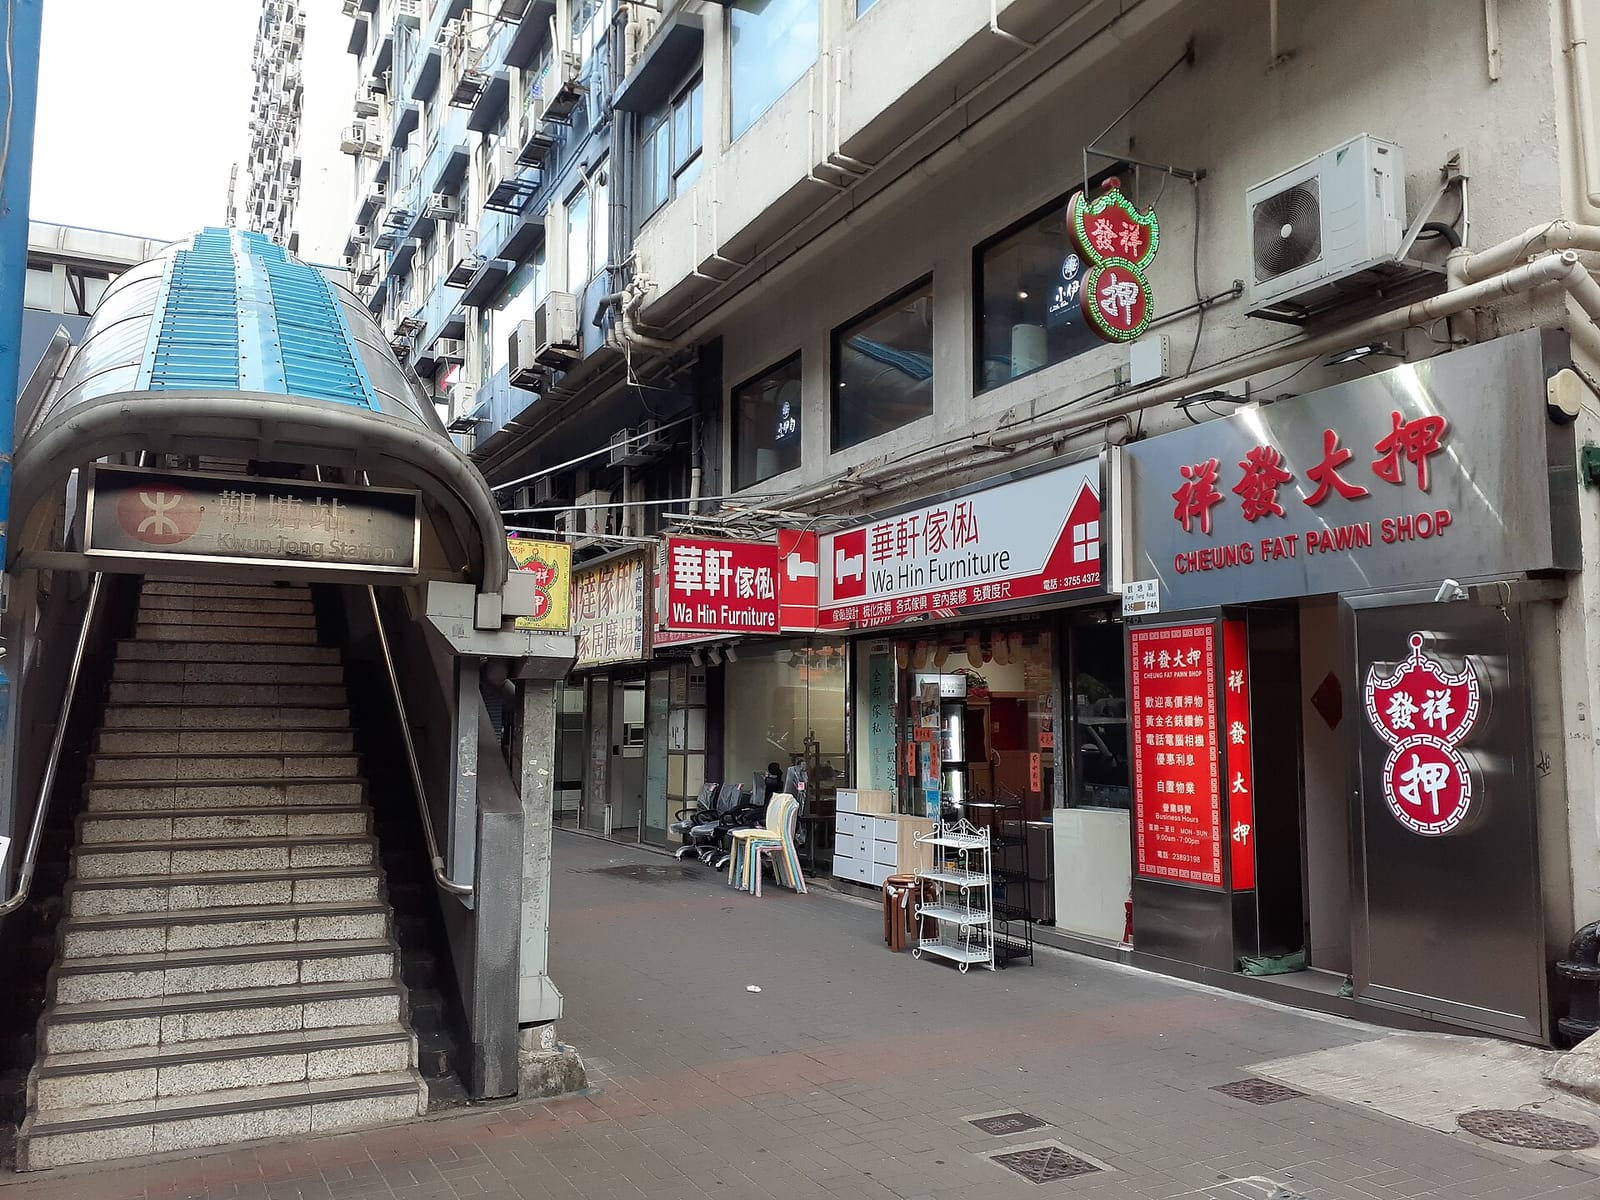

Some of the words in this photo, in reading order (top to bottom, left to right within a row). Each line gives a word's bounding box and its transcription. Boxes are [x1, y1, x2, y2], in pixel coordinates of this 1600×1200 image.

[1100, 272, 1139, 326] 押
[1171, 410, 1448, 535] 祥發大押
[218, 489, 347, 532] 觀塘站
[217, 533, 272, 551] Kwun
[276, 534, 324, 558] Tong
[329, 539, 395, 560] Station
[872, 501, 979, 565] 華軒傢俬
[1174, 543, 1254, 574] CHEUNG
[1260, 534, 1298, 562] FAT
[1306, 522, 1371, 555] PAWN
[1380, 509, 1452, 544] SHOP
[673, 545, 775, 600] 華軒傢俬
[872, 569, 893, 593] Wa
[898, 563, 924, 589] Hin
[929, 550, 1010, 584] Furniture
[1063, 575, 1081, 587] 3755
[1082, 572, 1100, 585] 4372
[673, 602, 693, 623] Wa
[697, 604, 717, 624] Hin
[721, 605, 776, 627] Furniture
[1143, 648, 1202, 670] 祥發大押
[1399, 753, 1451, 816] 押
[1155, 812, 1181, 822] Business
[1181, 815, 1199, 823] Hours
